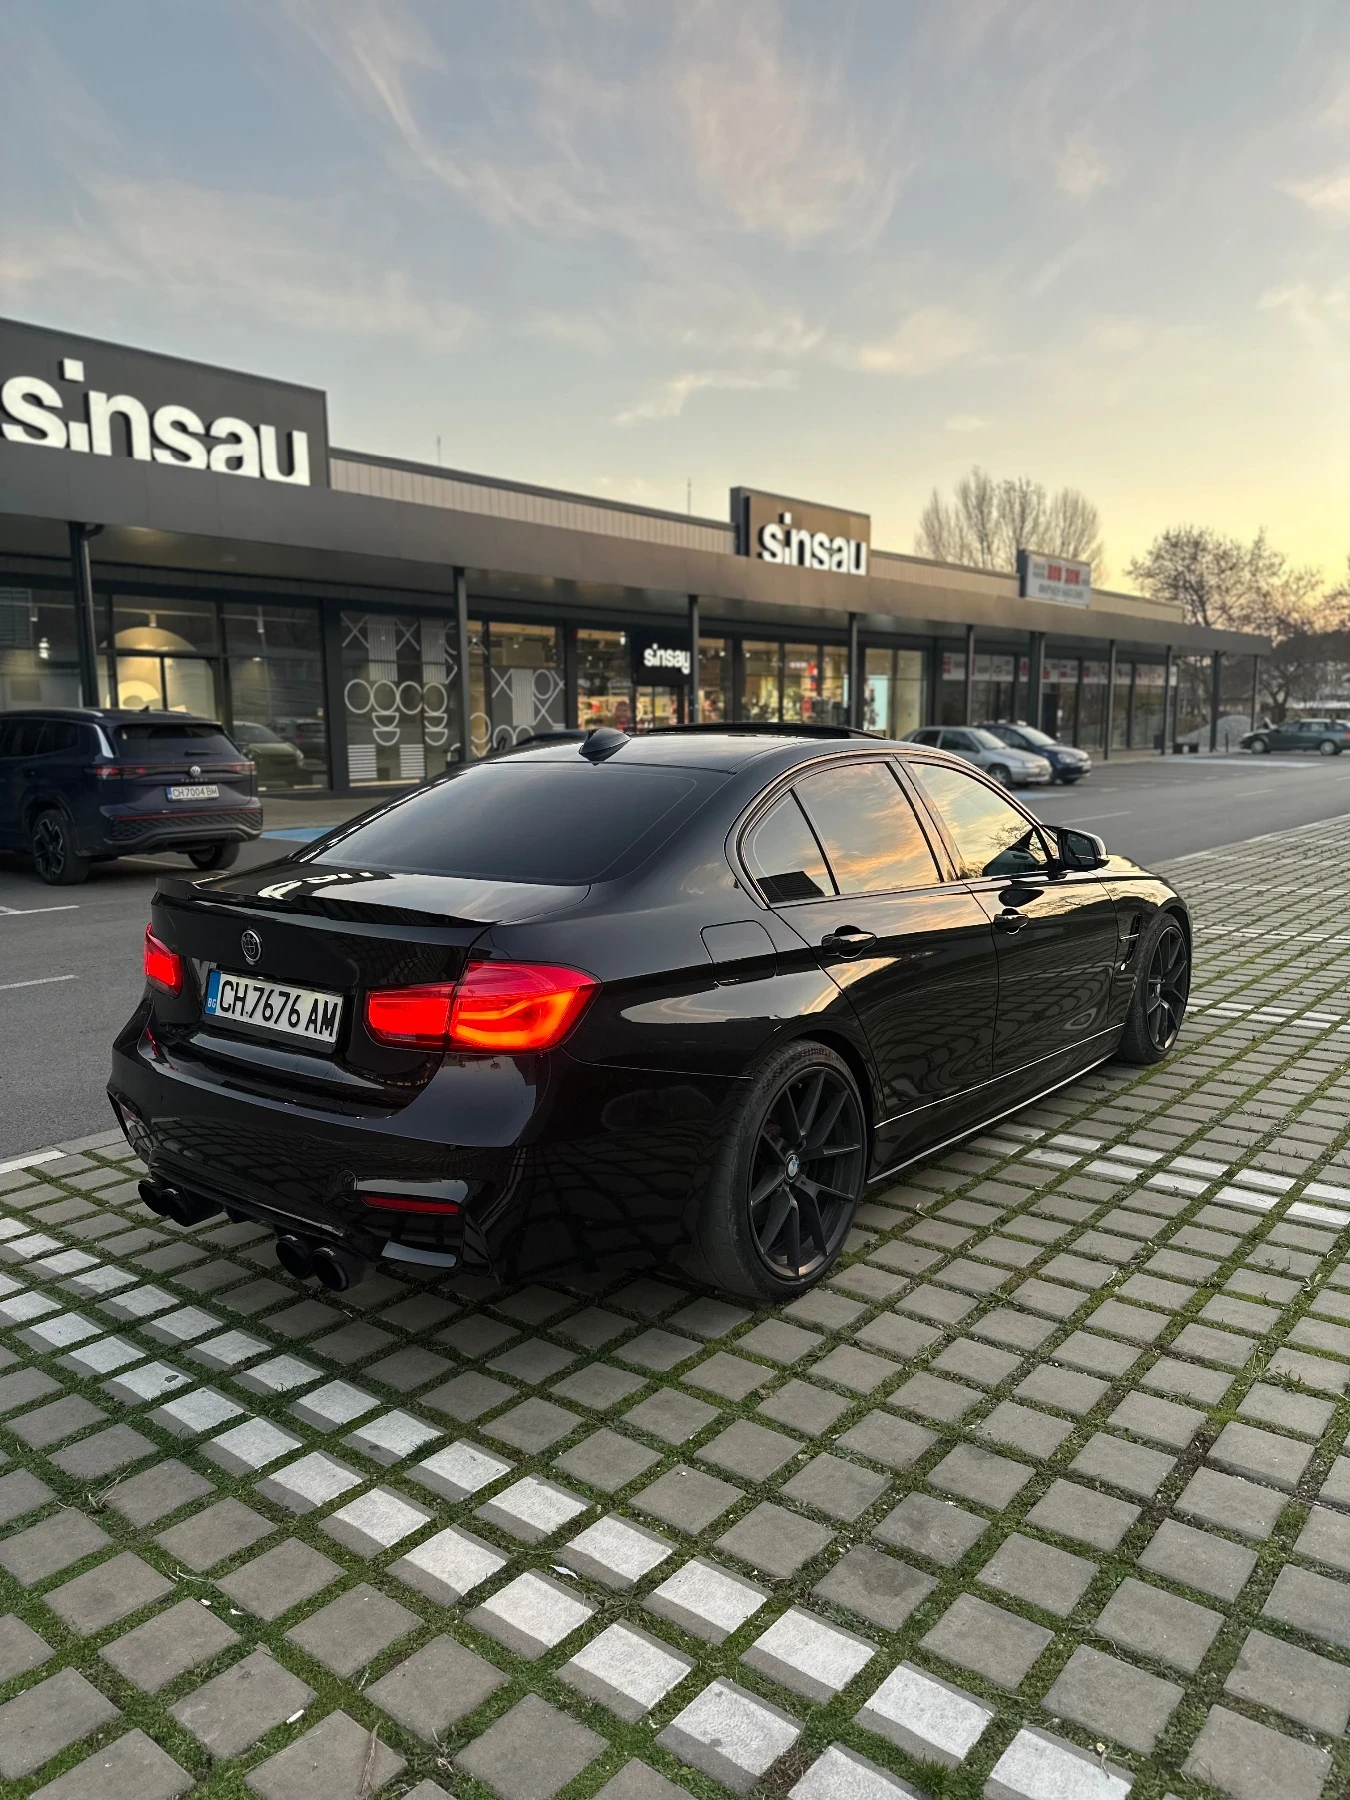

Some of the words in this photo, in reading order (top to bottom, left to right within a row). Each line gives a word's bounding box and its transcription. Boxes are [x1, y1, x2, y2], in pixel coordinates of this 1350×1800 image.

[643, 643, 691, 675] sinsay
[207, 998, 217, 1008] BG
[304, 998, 338, 1037] AM
